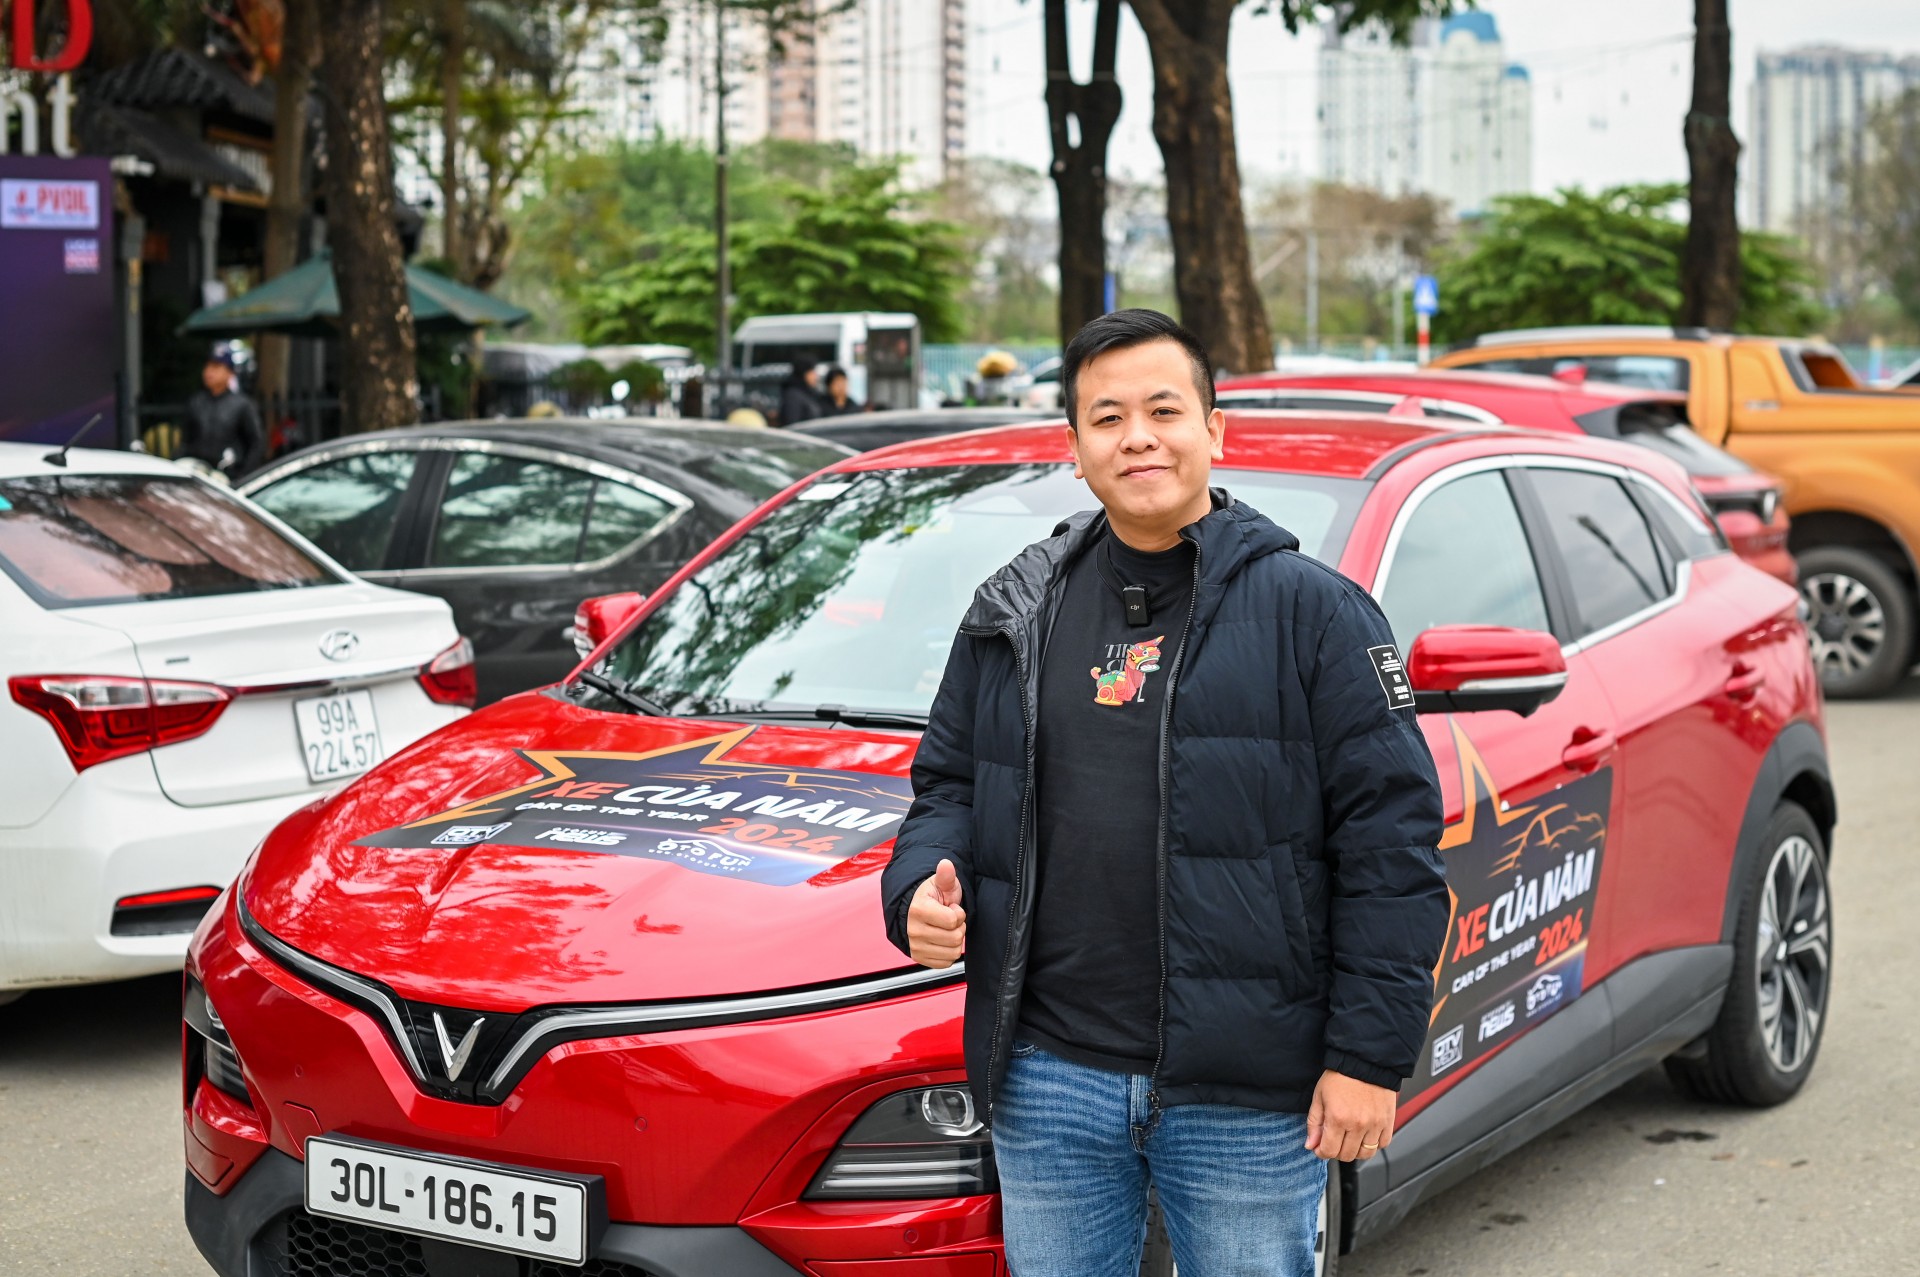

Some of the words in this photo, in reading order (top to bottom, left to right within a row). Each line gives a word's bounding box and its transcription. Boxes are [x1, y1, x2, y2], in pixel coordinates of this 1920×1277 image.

[317, 698, 359, 735] 99A
[308, 731, 376, 776] 224.57
[515, 802, 562, 811] CAR
[599, 806, 644, 816] THE
[648, 810, 709, 822] YEAR
[530, 781, 630, 799] XE
[613, 784, 742, 811] CỦA
[732, 793, 904, 833] NĂM
[697, 816, 844, 855] 2024
[1452, 903, 1490, 963] XE
[1488, 875, 1538, 942] CỦA
[1539, 848, 1596, 916] NĂM
[1535, 907, 1584, 966] 2024
[1452, 970, 1475, 994] CAR
[1474, 962, 1490, 981] OF
[1490, 950, 1509, 973] THE
[1510, 935, 1537, 961] YEAR
[330, 1158, 557, 1242] 30L-186.15
